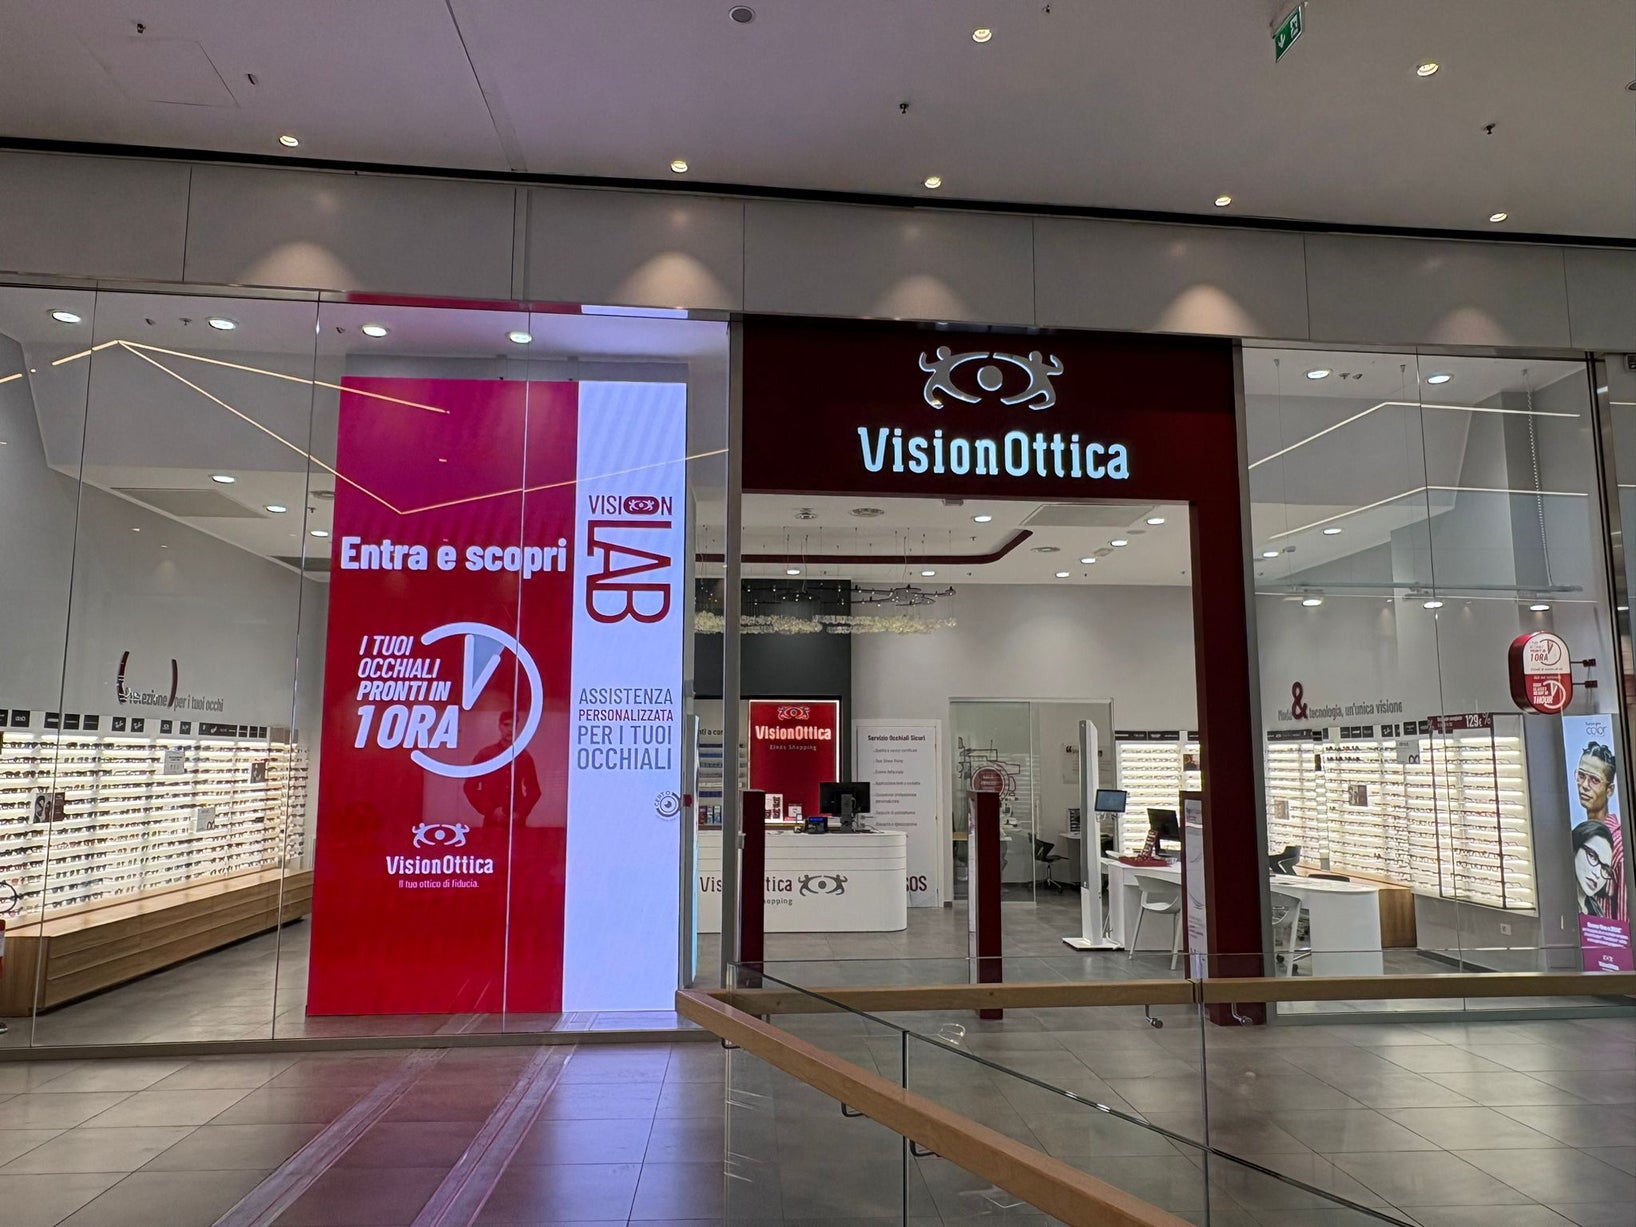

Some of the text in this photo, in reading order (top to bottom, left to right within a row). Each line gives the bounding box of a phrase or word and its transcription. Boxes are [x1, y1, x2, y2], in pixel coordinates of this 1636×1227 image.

[857, 426, 1130, 480] VisionOttica
[588, 495, 673, 515] VISION
[340, 536, 567, 580] Entra e scopri
[586, 519, 672, 624] LAB
[359, 635, 414, 656] I TUOI
[357, 657, 441, 678] OCCHIALI
[356, 680, 452, 701] PRONTI IN
[579, 688, 673, 704] ASSISTENZA
[579, 709, 674, 721] PERSONALIZZATA
[354, 704, 459, 749] 1 ORA
[578, 725, 672, 745] PER I TUOI
[755, 725, 832, 740] VisionOttica
[577, 748, 672, 770] OCCHIALI
[386, 855, 494, 875] VisionOttica
[405, 880, 418, 889] tuo
[419, 879, 441, 888] ottico
[442, 879, 450, 888] di
